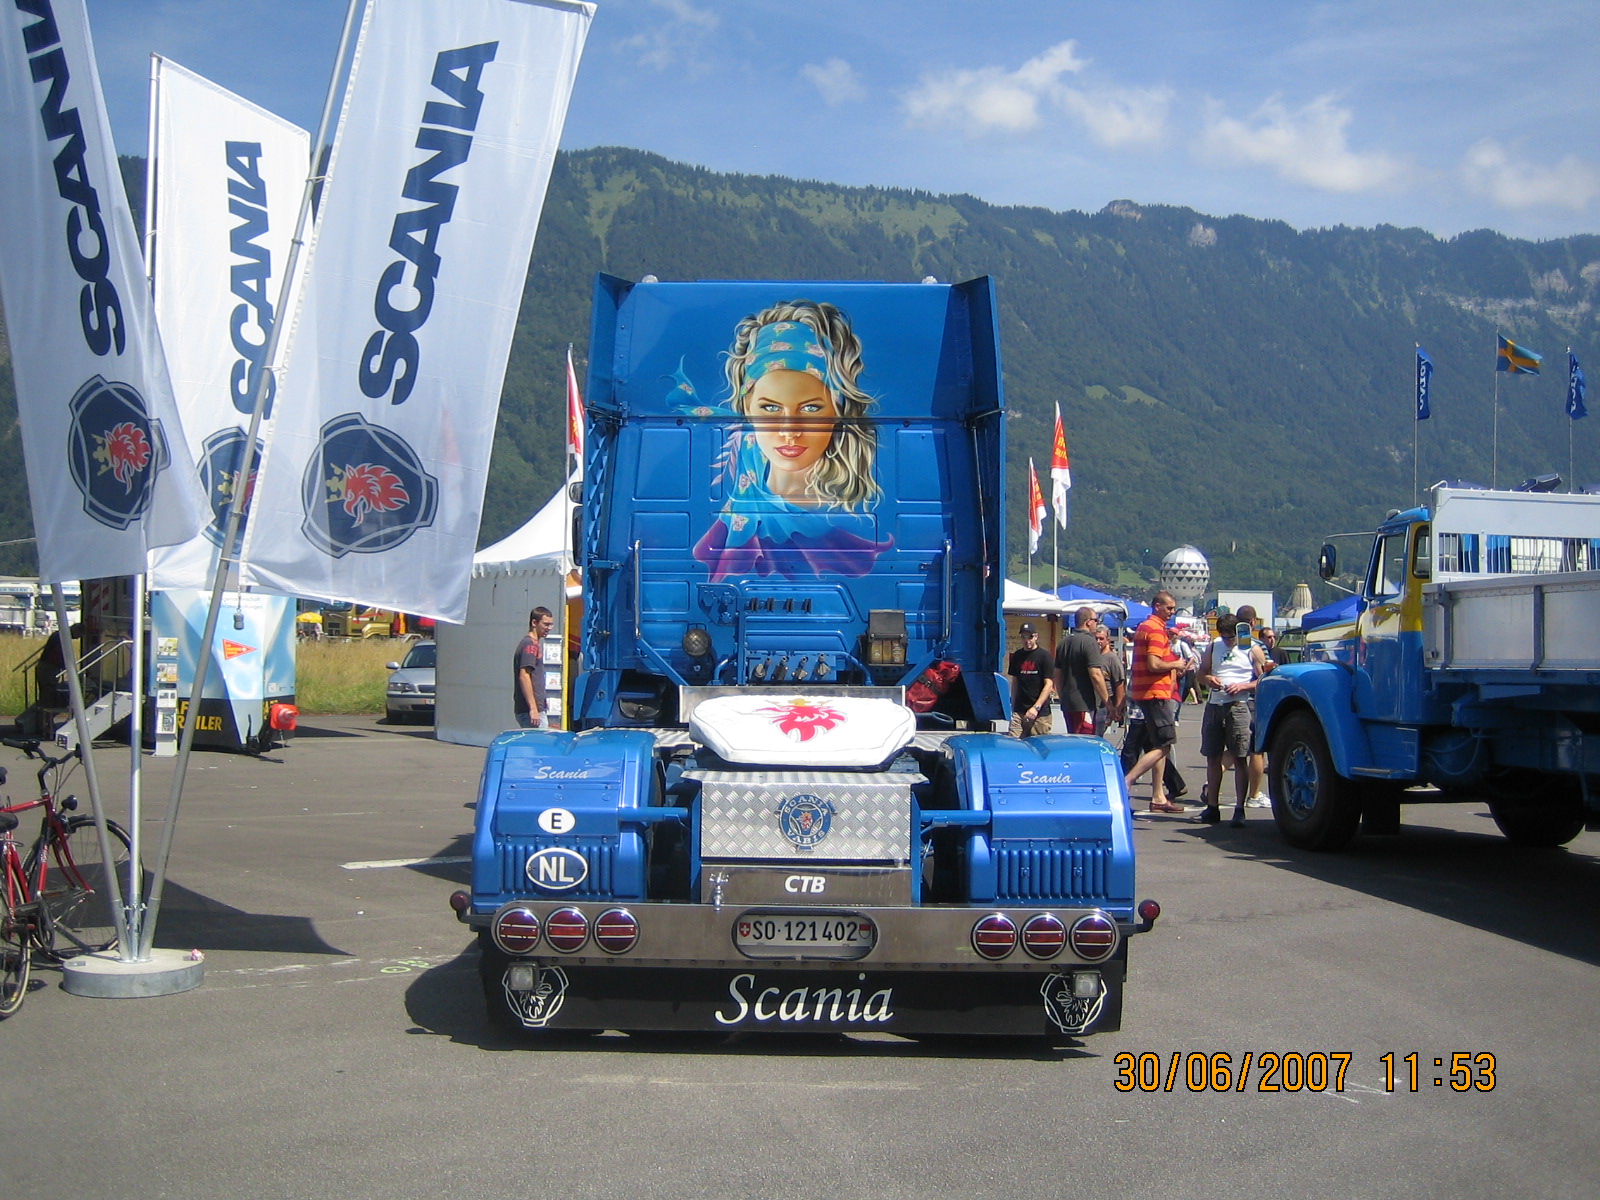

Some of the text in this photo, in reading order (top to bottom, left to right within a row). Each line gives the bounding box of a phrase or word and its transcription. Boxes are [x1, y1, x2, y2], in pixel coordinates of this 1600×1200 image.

[15, 0, 126, 357] SCANI
[359, 40, 499, 405] SCANIA
[225, 140, 277, 420] SCANIA
[534, 765, 590, 780] Scania
[1018, 770, 1072, 784] Scania
[551, 812, 562, 830] E
[539, 856, 575, 882] NL
[784, 875, 827, 893] CTB
[714, 972, 894, 1025] Scania
